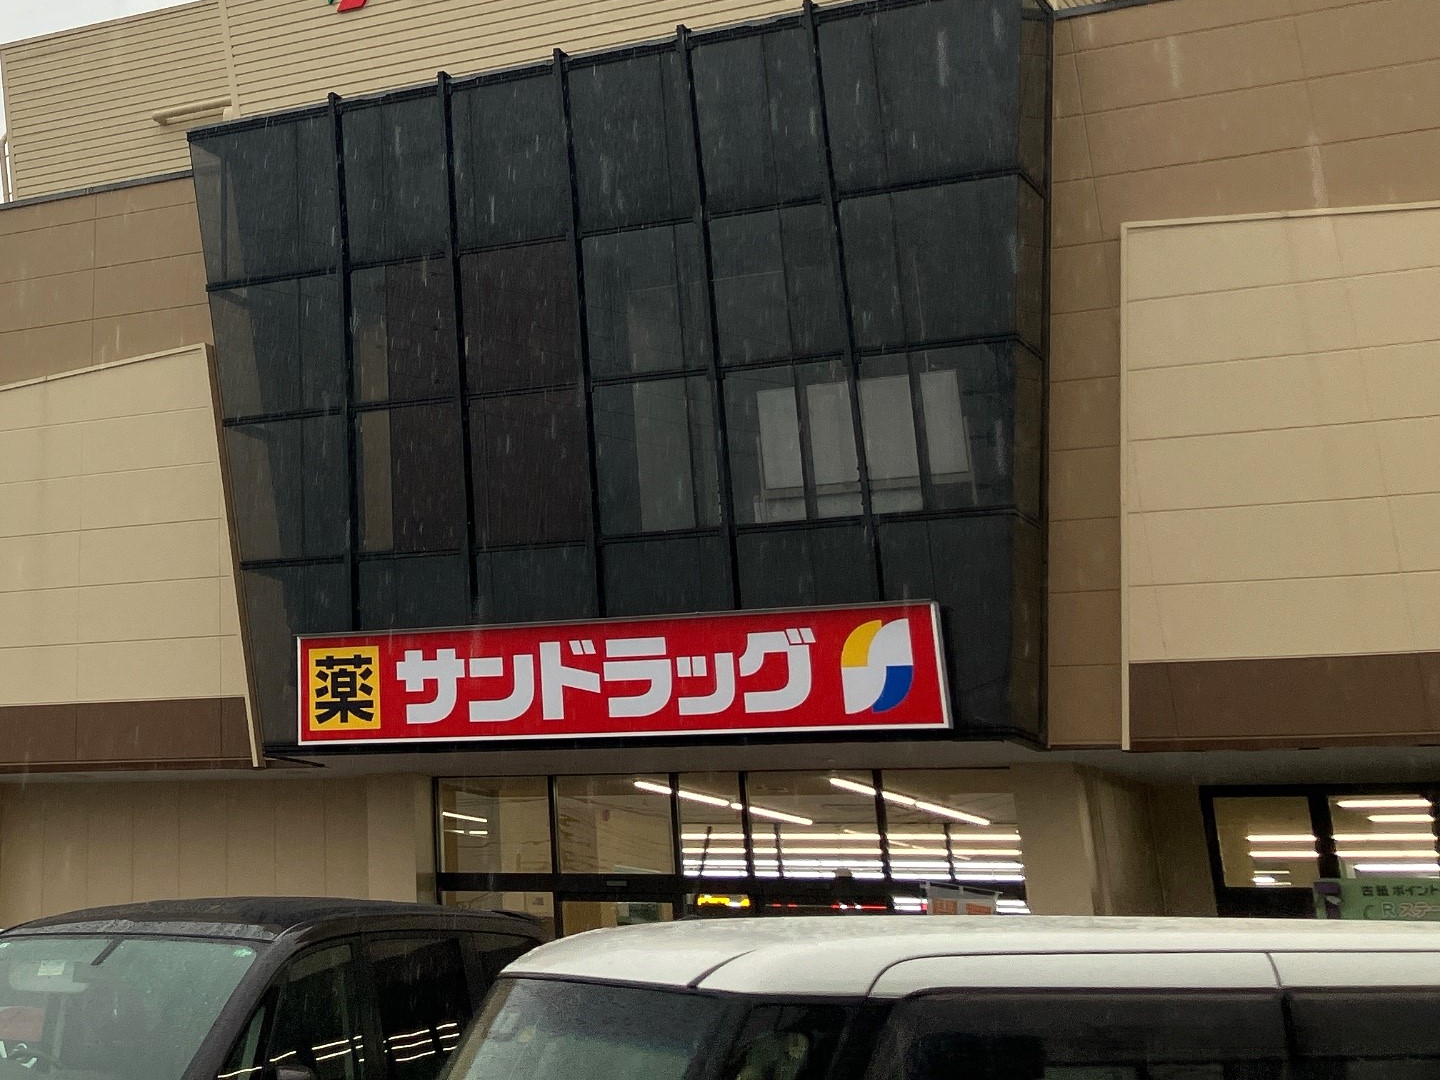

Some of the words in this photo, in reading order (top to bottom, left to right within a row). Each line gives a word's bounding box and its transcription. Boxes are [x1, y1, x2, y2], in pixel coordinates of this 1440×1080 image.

[314, 654, 374, 725] 薬
[396, 627, 817, 725] サンドラッグ
